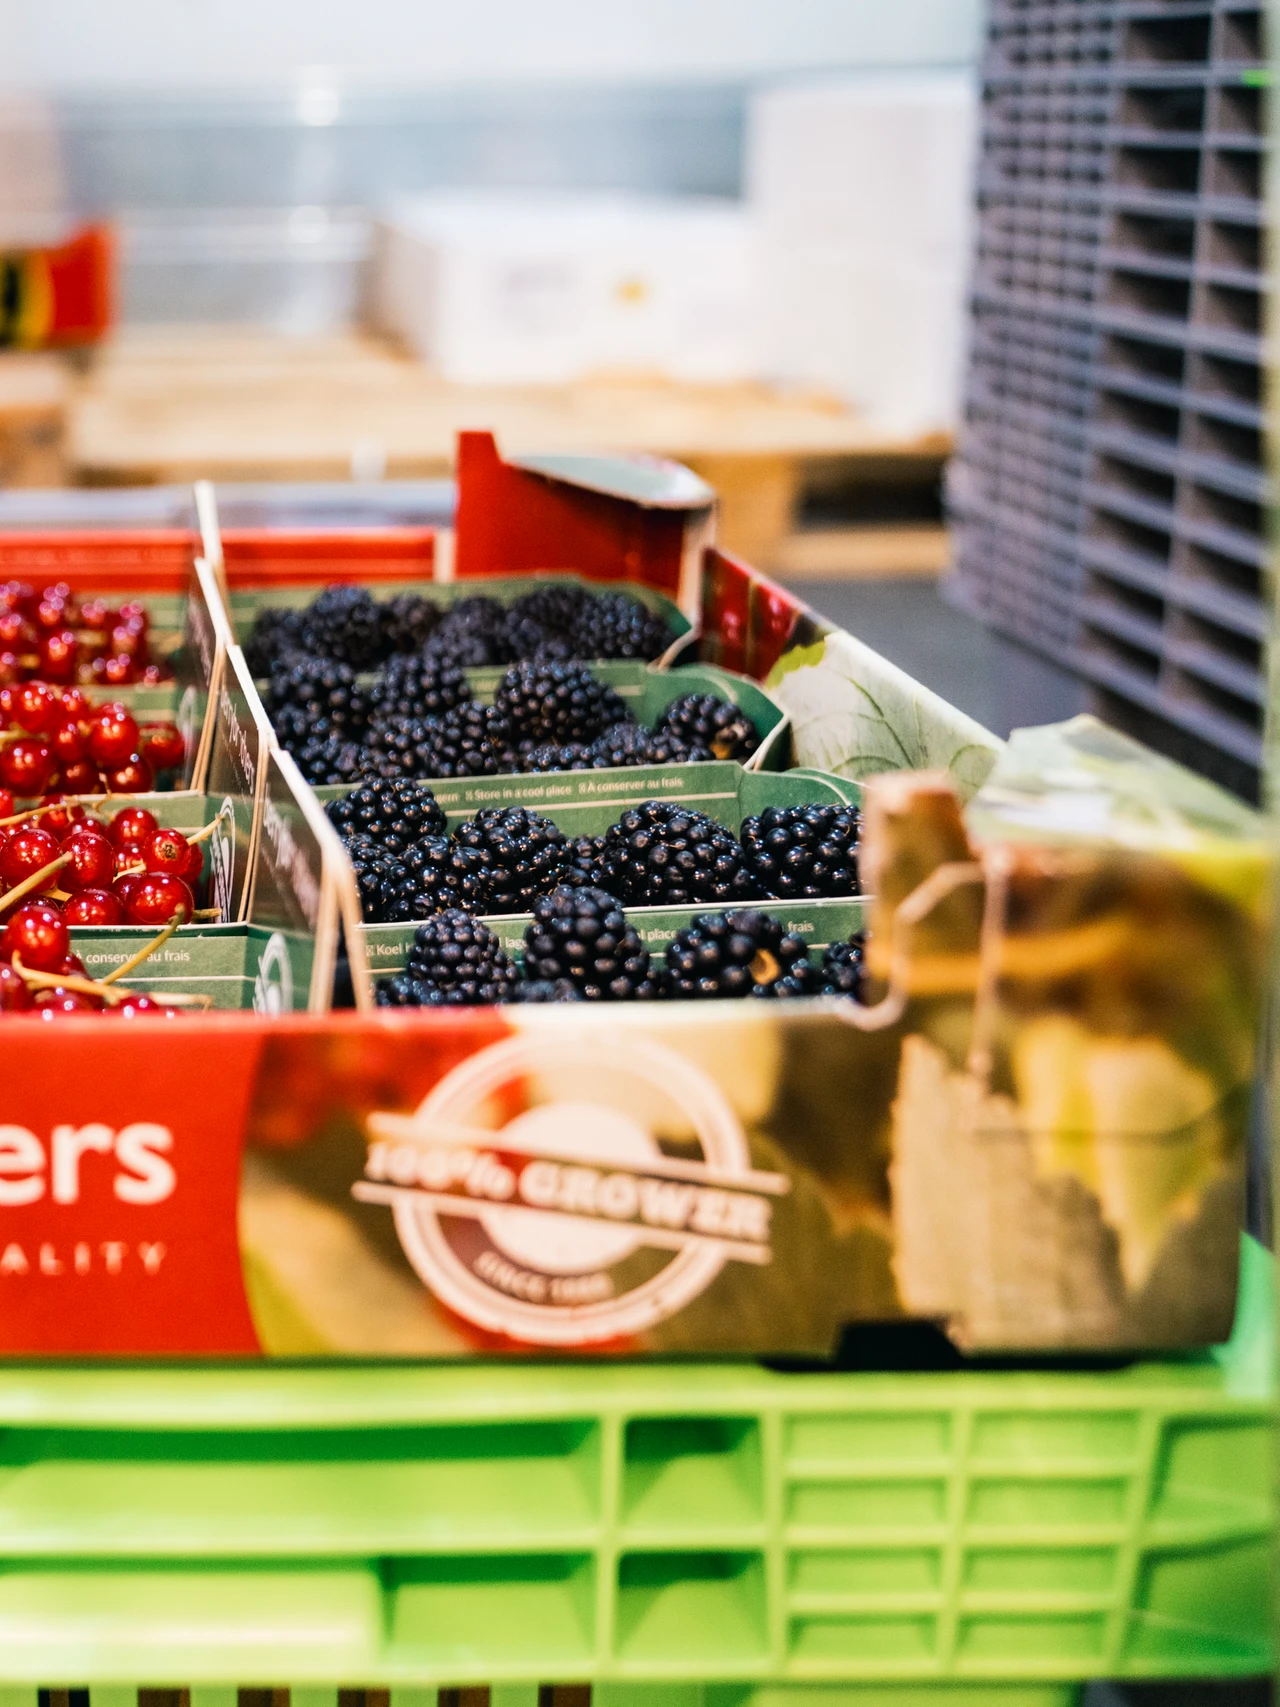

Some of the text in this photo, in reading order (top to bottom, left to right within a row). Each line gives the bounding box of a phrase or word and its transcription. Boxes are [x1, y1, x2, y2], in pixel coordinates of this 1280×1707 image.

[474, 789, 501, 800] Store
[503, 788, 513, 799] in
[514, 788, 521, 798] a
[522, 786, 544, 798] cool
[546, 784, 572, 798] place
[597, 780, 645, 792] conserver
[647, 779, 659, 789] au
[661, 777, 683, 788] frais
[376, 943, 403, 955] Koel
[787, 921, 815, 933] frais
[146, 952, 161, 962] au
[164, 950, 190, 962] frais
[365, 1142, 773, 1242] 100% GROWER
